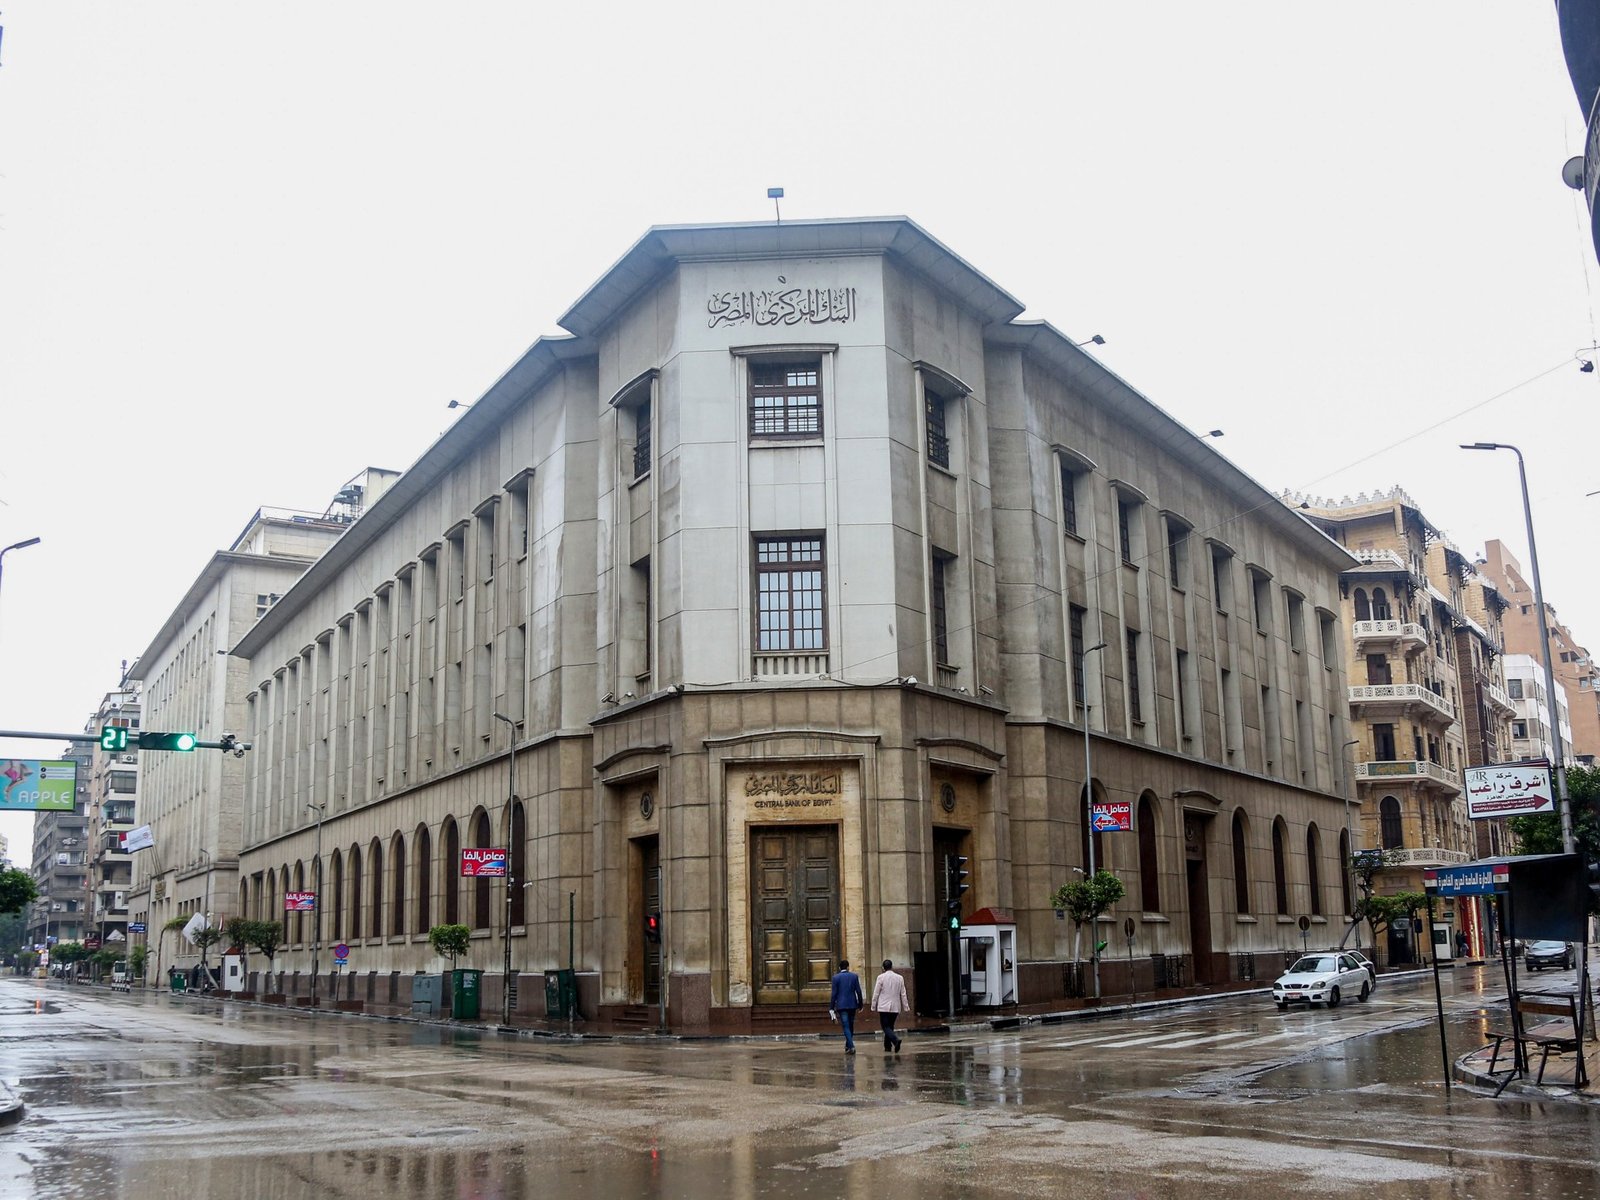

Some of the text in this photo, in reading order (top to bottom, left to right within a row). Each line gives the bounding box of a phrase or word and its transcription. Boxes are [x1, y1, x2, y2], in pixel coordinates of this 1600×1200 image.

[811, 288, 857, 325] البنك
[103, 729, 126, 749] 21
[1496, 771, 1512, 780] شركة
[810, 774, 842, 795] البنك
[1470, 774, 1546, 796] أشرف راغب
[18, 790, 70, 804] APPLE
[754, 799, 832, 808] CENTRAL BANK OF EGYPT
[1093, 804, 1129, 816] معامل الفا
[463, 851, 505, 863] معامل الفا
[1438, 873, 1453, 891] القاهرة
[1465, 872, 1479, 886] العامة
